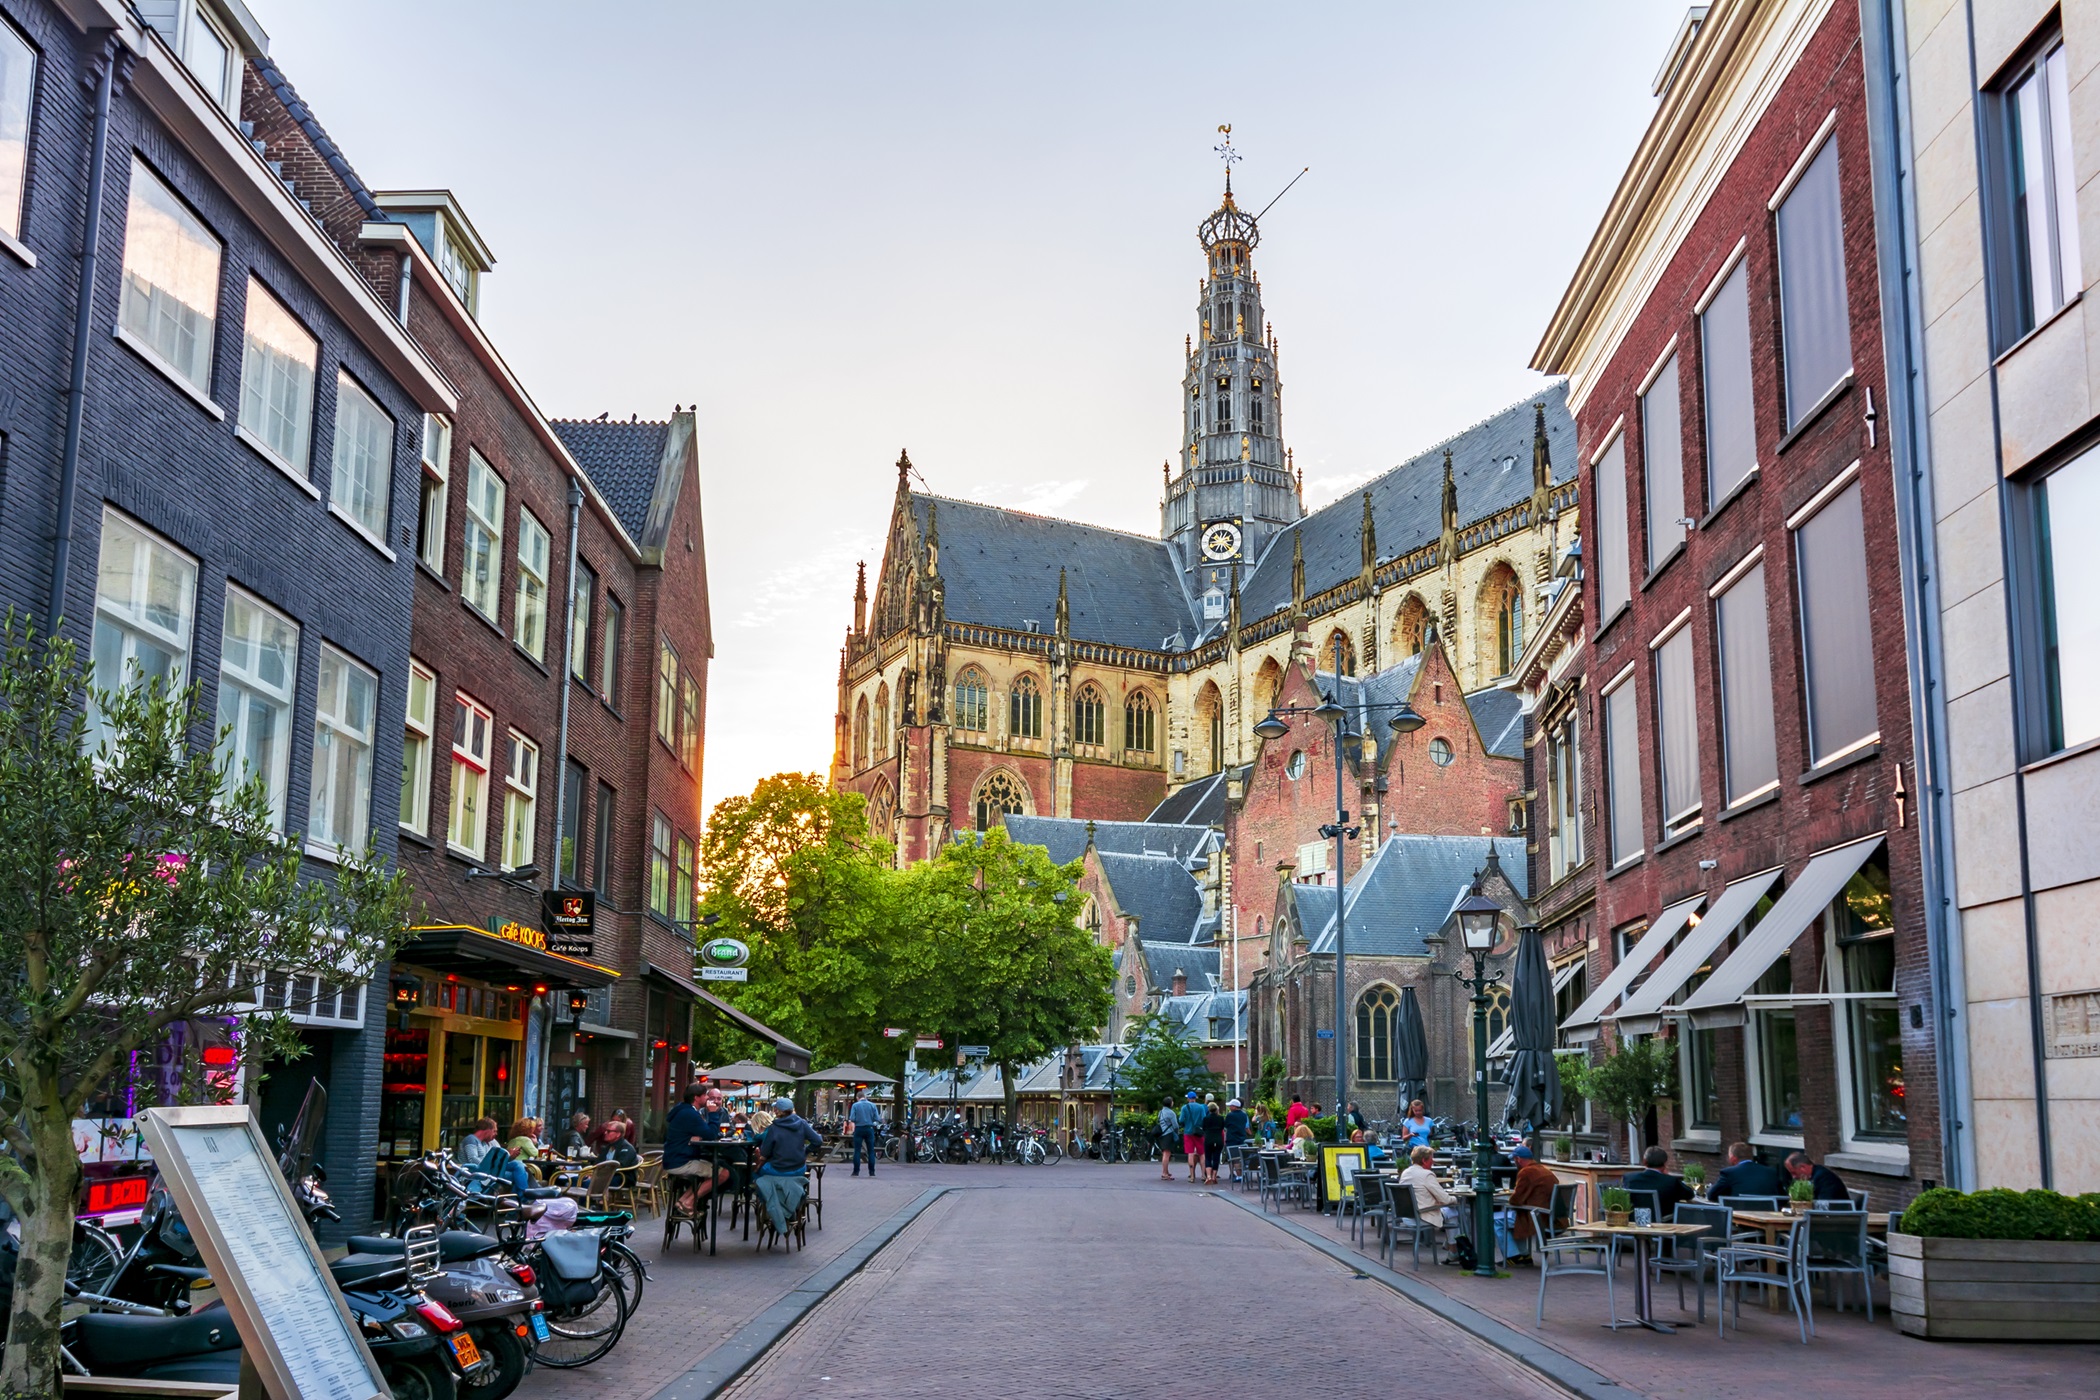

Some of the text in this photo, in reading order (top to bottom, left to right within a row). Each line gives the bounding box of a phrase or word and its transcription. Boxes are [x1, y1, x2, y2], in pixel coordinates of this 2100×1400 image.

[555, 915, 588, 924] Hertog Jan
[520, 926, 546, 950] KOOPS
[711, 946, 738, 957] Brand
